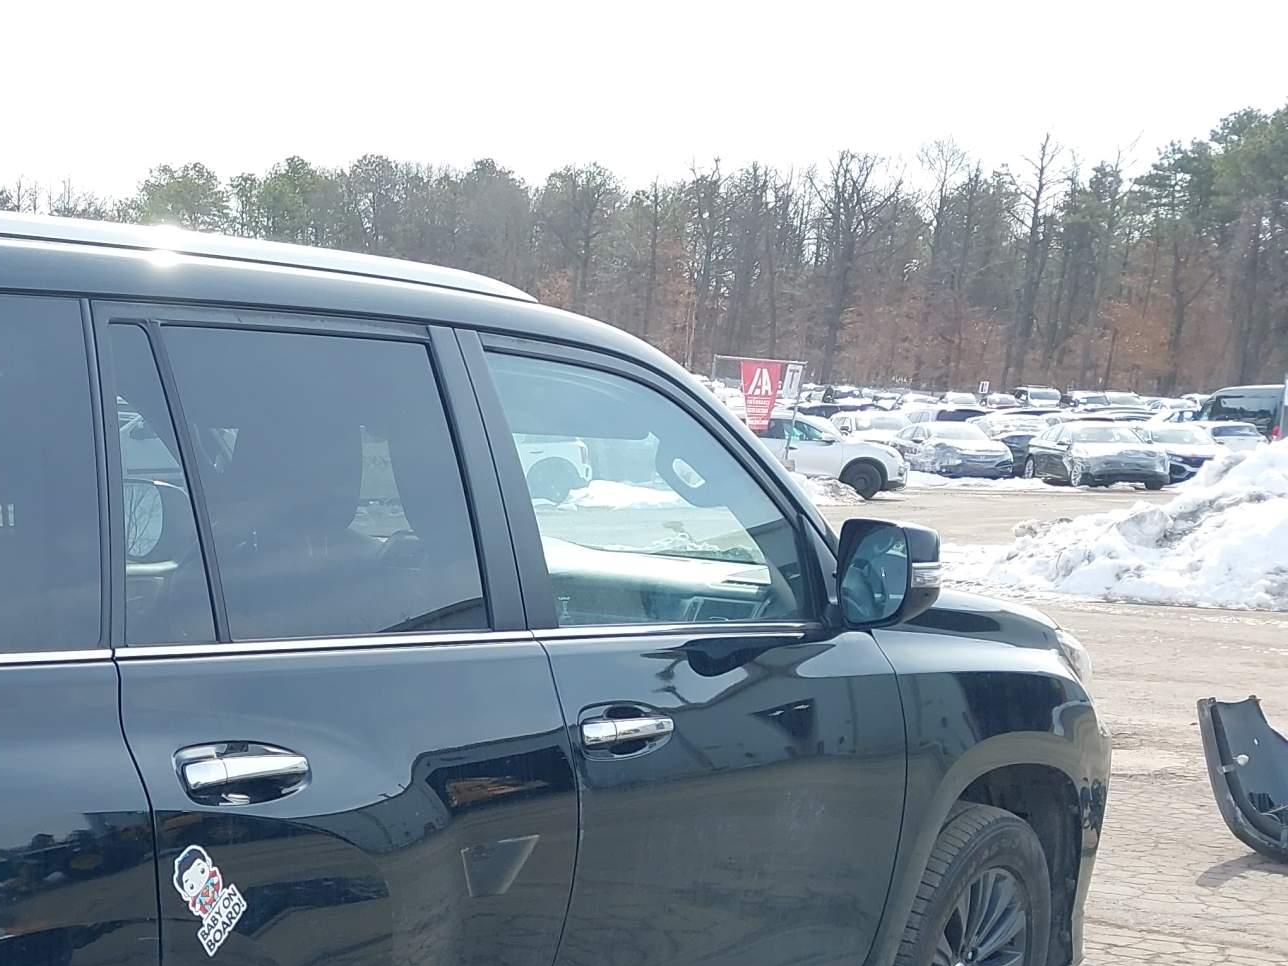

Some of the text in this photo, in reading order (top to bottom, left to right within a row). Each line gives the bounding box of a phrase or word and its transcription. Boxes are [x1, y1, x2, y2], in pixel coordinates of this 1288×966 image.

[200, 888, 238, 941] BABY ON
[206, 898, 245, 950] BOARD!
